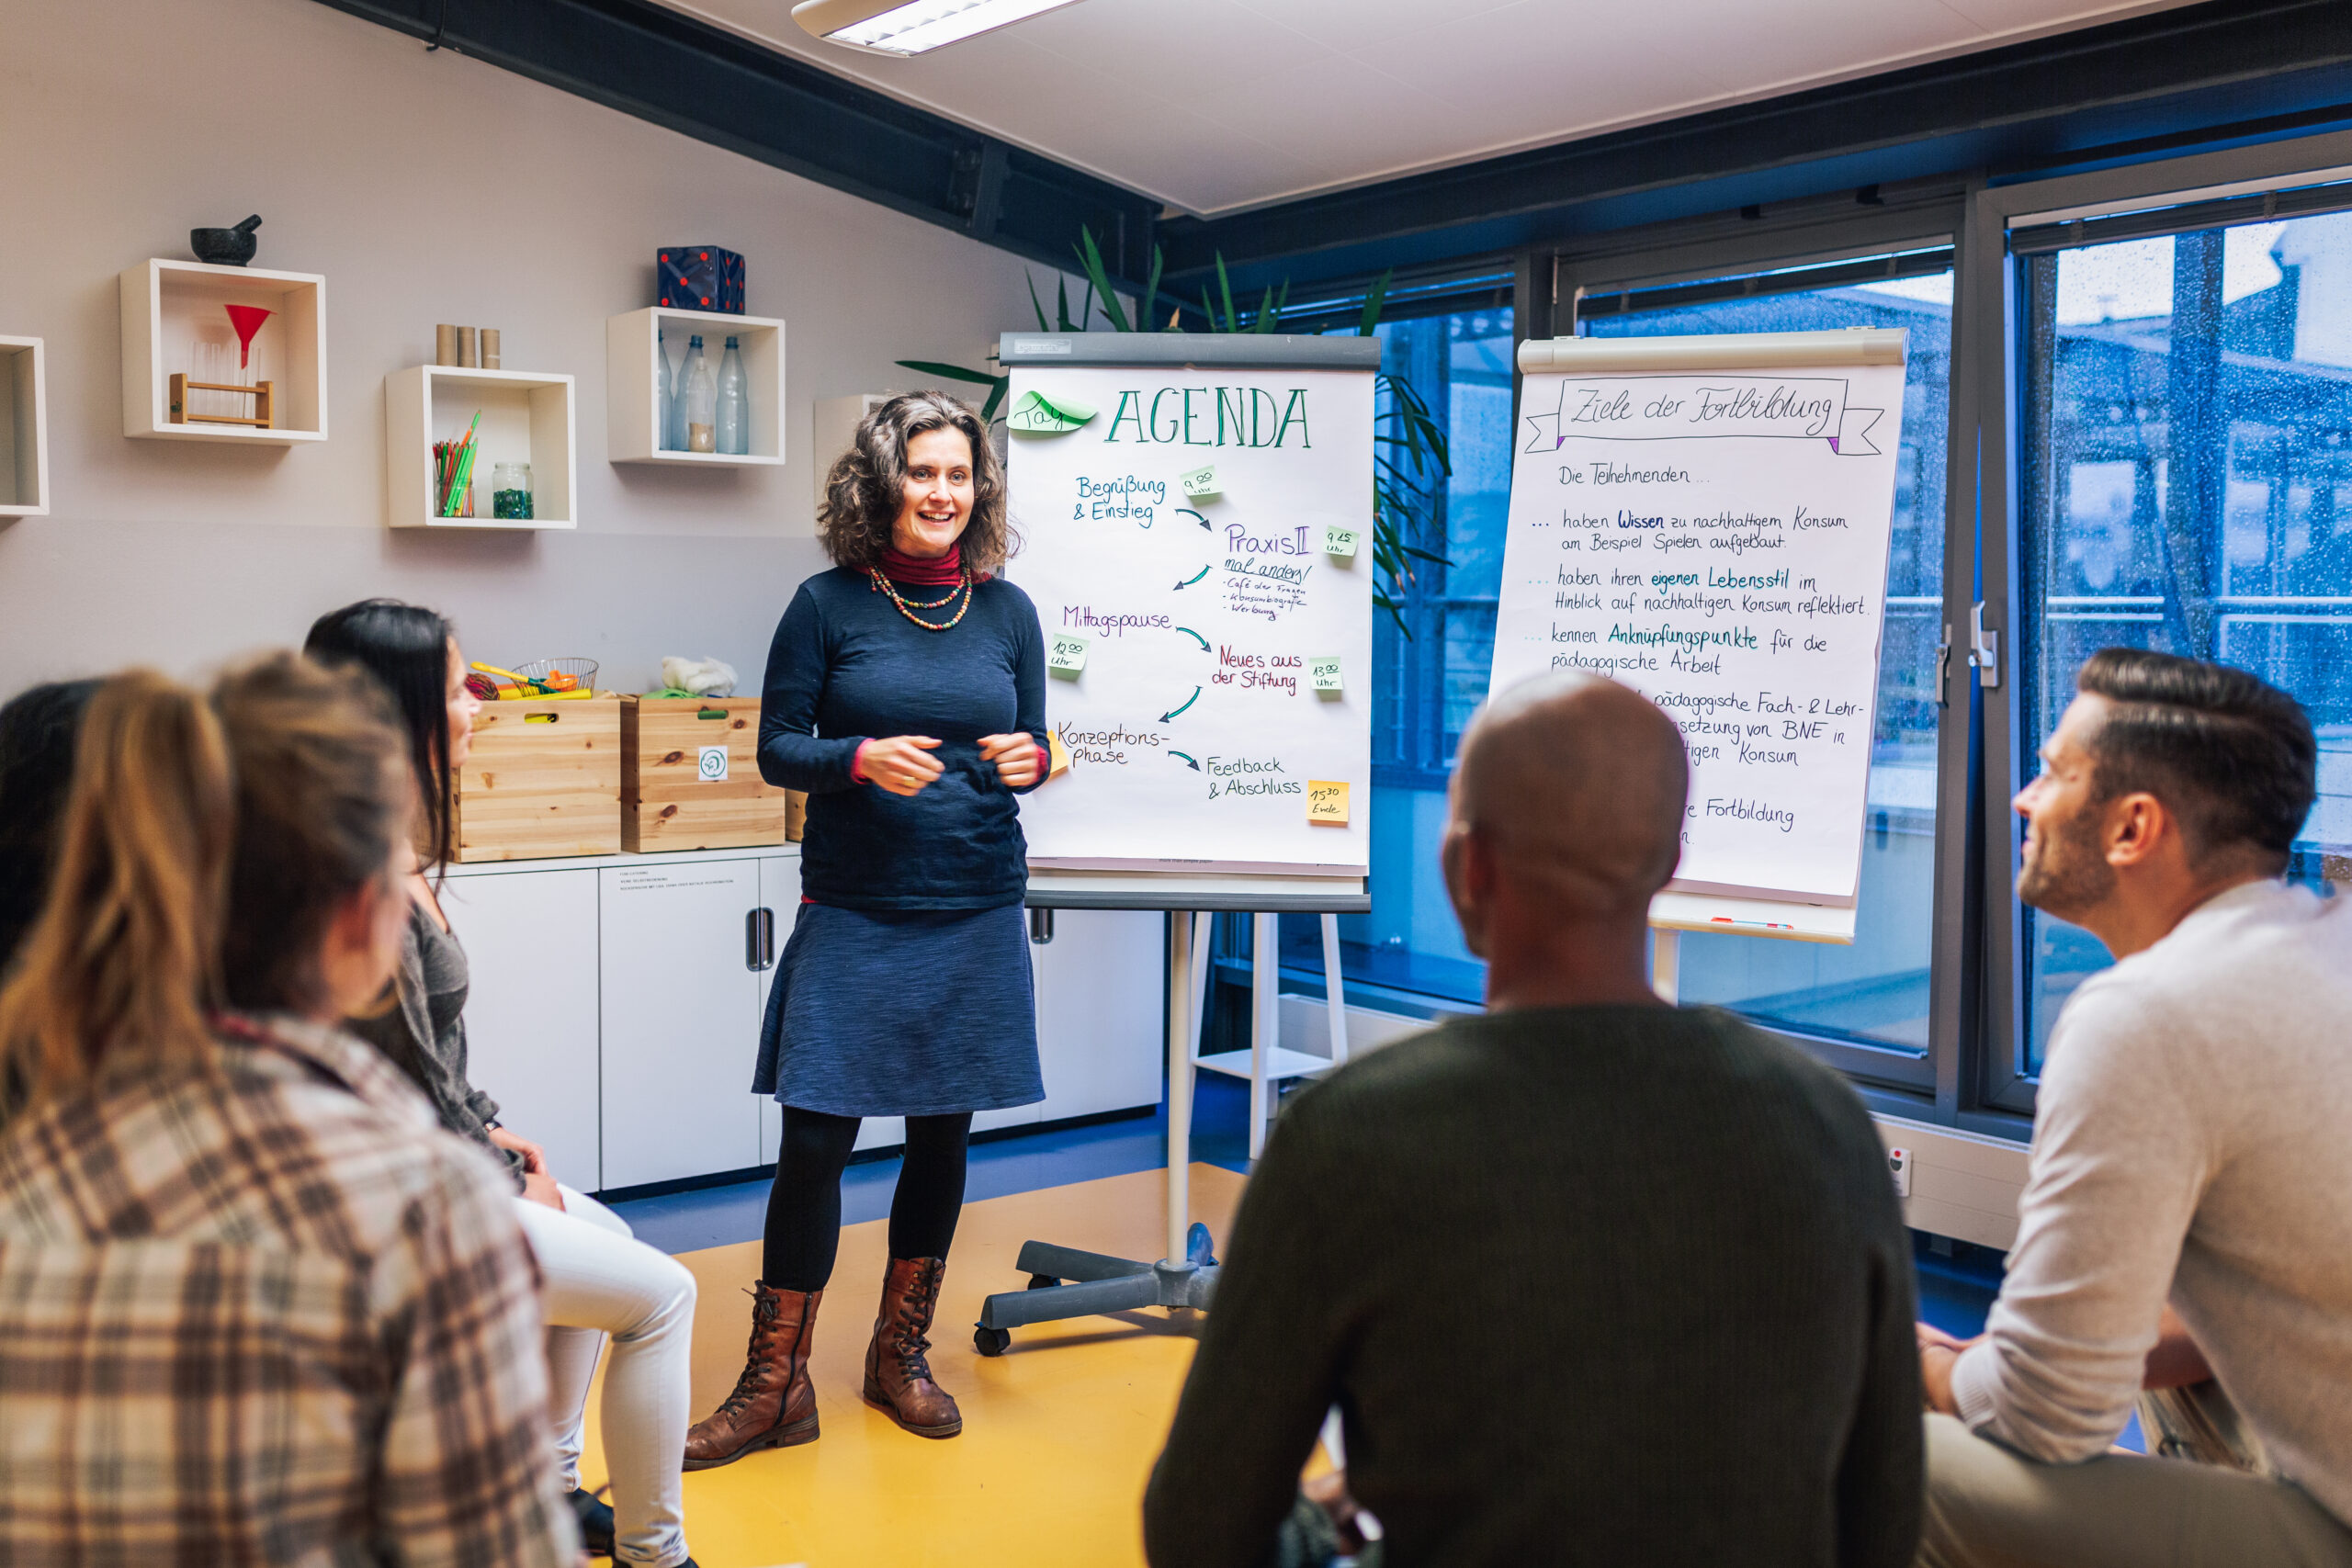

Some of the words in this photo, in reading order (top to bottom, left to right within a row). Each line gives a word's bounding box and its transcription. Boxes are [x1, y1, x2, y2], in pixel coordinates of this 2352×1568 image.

[1014, 397, 1064, 432] Tag
[1103, 387, 1312, 448] AGENDA
[1571, 389, 1633, 423] Ziele
[1645, 394, 1686, 418] der
[1689, 386, 1833, 436] Fortbildung
[1559, 466, 1584, 485] Die
[1589, 461, 1690, 485] Teilnehmenden
[1076, 475, 1165, 504] Begrüßung
[1073, 503, 1085, 520] &
[1092, 501, 1153, 529] Einstieg
[1563, 509, 1609, 528] haben
[1618, 509, 1664, 529] Wissen
[1671, 517, 1687, 528] zu
[1693, 511, 1782, 538] nachhaltigem
[1793, 505, 1849, 530] Konsum
[1562, 539, 1580, 551] am
[1589, 533, 1642, 553] Beispiel
[1654, 533, 1702, 555] Spielen
[1710, 533, 1786, 556] aufgebaut.
[1225, 557, 1254, 573] mal
[1255, 581, 1271, 591] der
[1558, 563, 1601, 585] haben
[1611, 568, 1644, 586] ihren
[1651, 570, 1700, 595] eigenen
[1708, 566, 1789, 589] Lebensstil
[1799, 574, 1817, 592] im
[1232, 604, 1279, 621] Werbung
[1555, 591, 1602, 610] Hinblick
[1611, 592, 1636, 614] auf
[1645, 592, 1735, 617] nachhaltigen
[1743, 593, 1792, 615] Konsum
[1798, 594, 1870, 619] reflektiert.
[1063, 605, 1172, 637] Mittagspause
[1552, 622, 1598, 643] kennen
[1608, 622, 1758, 654] Anknüpfungspunkte
[1770, 628, 1793, 654] für
[1804, 636, 1827, 652] die
[1220, 645, 1265, 668] Neues
[1272, 655, 1302, 668] aus
[1551, 650, 1659, 679] pädagogische
[1670, 653, 1722, 676] Arbeit
[1212, 670, 1237, 684] der
[1241, 671, 1296, 696] Stiftung
[1808, 699, 1820, 713] &
[1826, 699, 1864, 716] Lehr-
[1058, 721, 1170, 750] Konzeptions-
[1747, 725, 1771, 737] von
[1782, 720, 1828, 739] BNE
[1834, 729, 1845, 745] in
[1073, 747, 1128, 768] phase
[1207, 756, 1285, 775] Feedback
[1739, 741, 1798, 766] Konsum
[1208, 783, 1220, 799] &
[1226, 778, 1302, 795] Abschluss
[1312, 804, 1340, 814] Ende
[1706, 798, 1794, 832] Fortbildung
